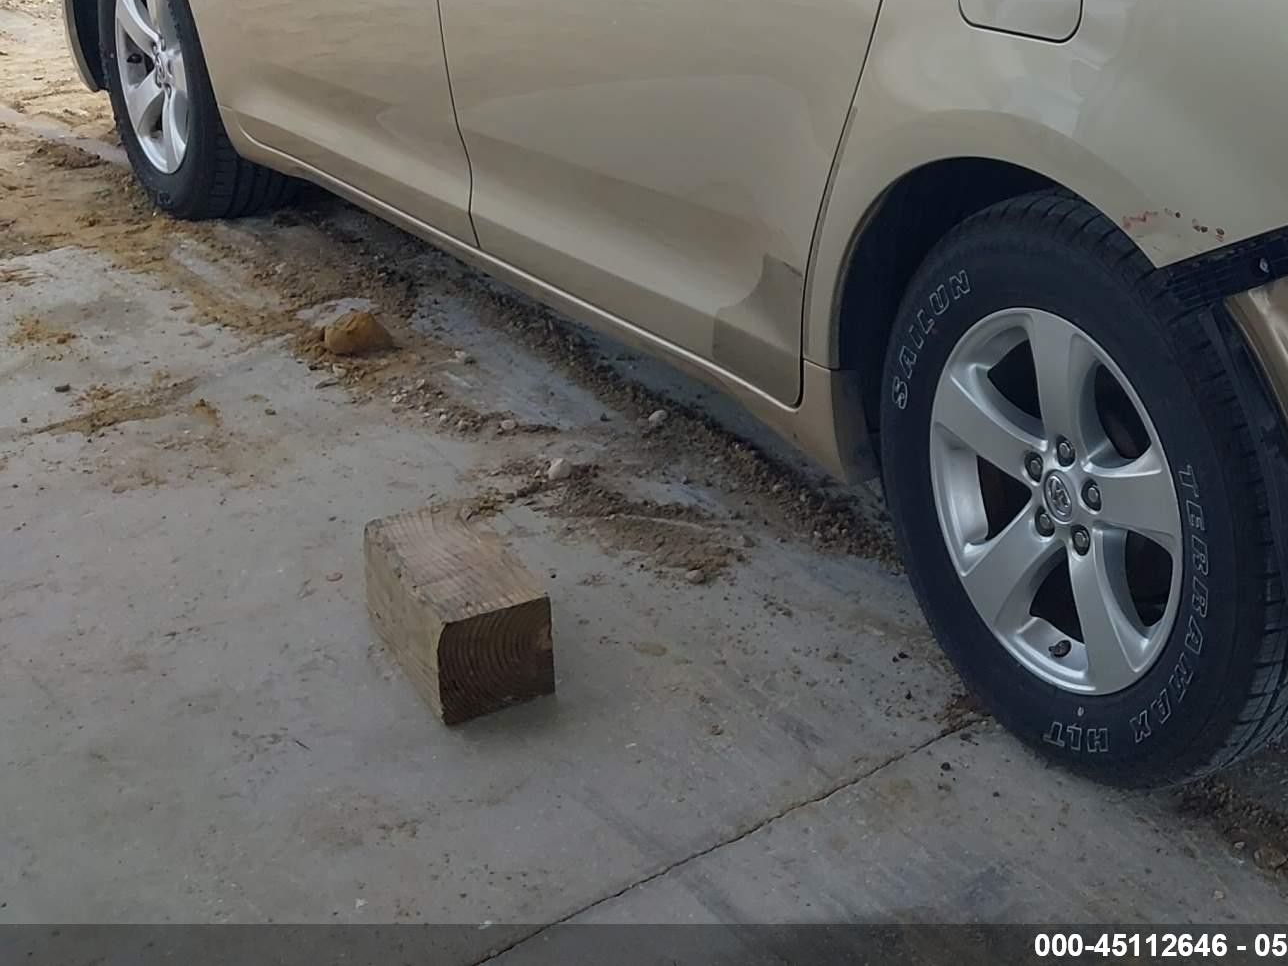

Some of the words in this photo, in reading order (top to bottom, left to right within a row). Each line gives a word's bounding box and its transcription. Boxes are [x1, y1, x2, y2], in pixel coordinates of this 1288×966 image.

[892, 269, 971, 410] SAILUN
[1128, 464, 1209, 743] TERRAMAX
[1042, 721, 1109, 753] HLT
